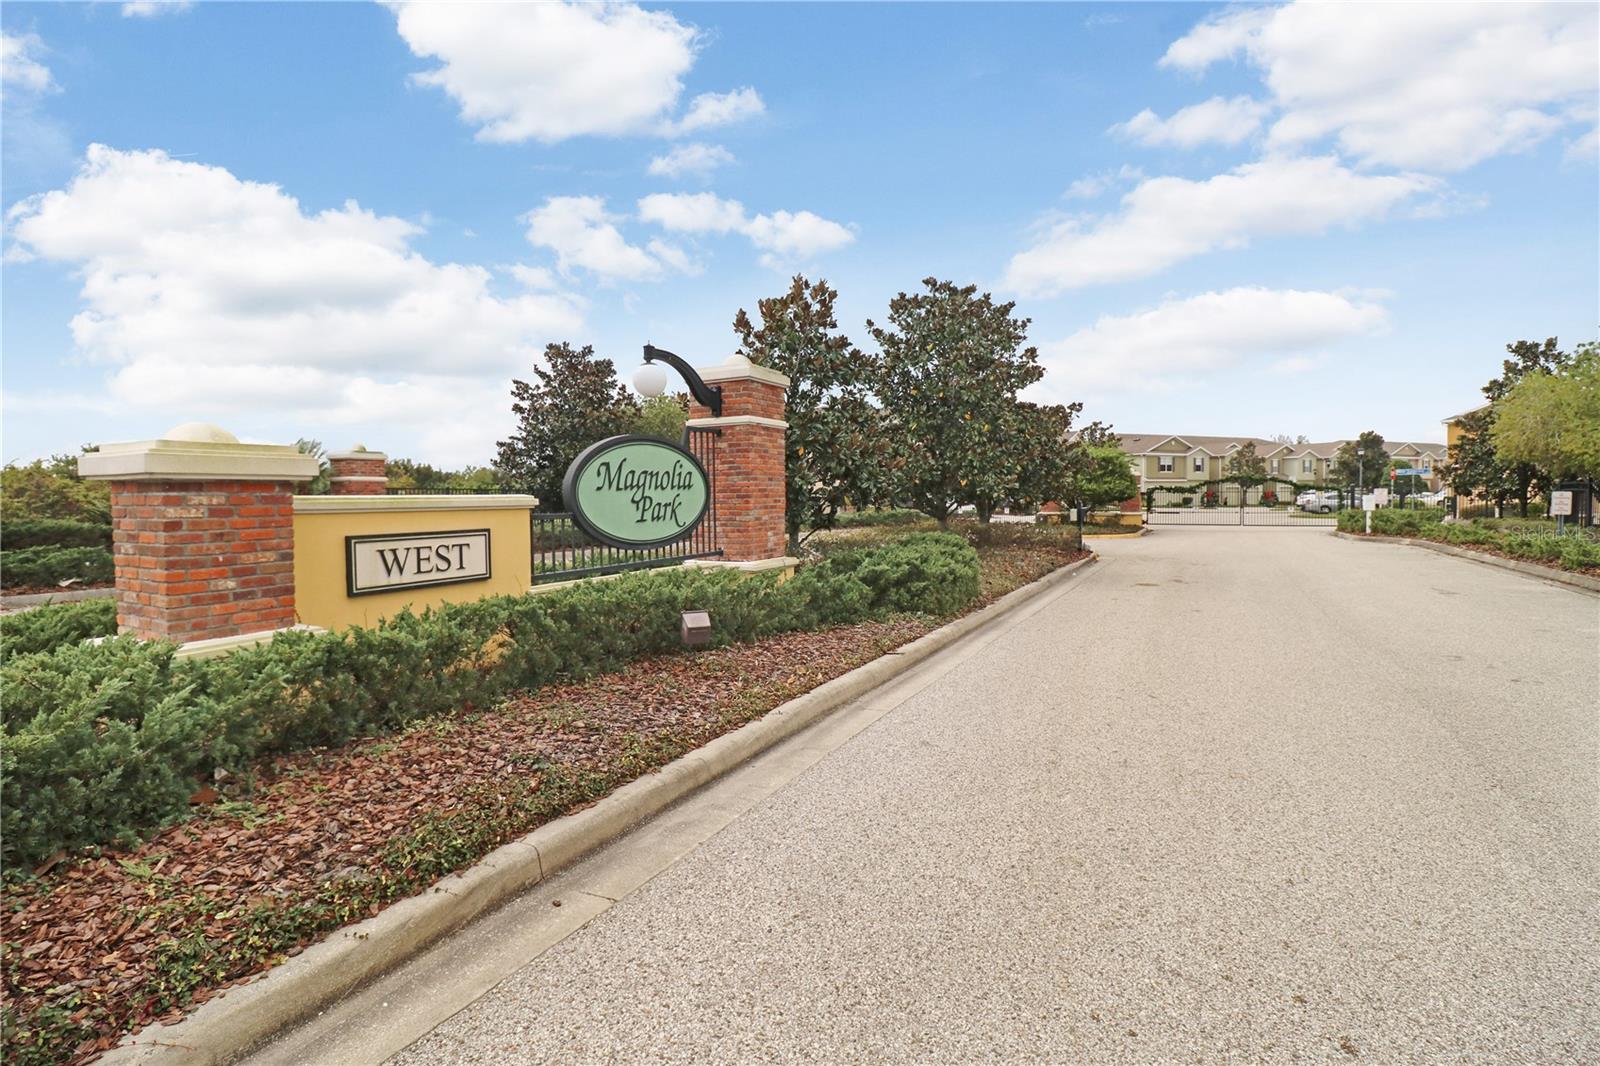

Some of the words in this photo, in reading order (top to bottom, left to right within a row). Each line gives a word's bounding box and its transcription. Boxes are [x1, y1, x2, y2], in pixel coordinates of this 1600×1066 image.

[596, 457, 694, 505] Magnolia
[635, 493, 687, 528] Park
[376, 543, 470, 577] WEST
